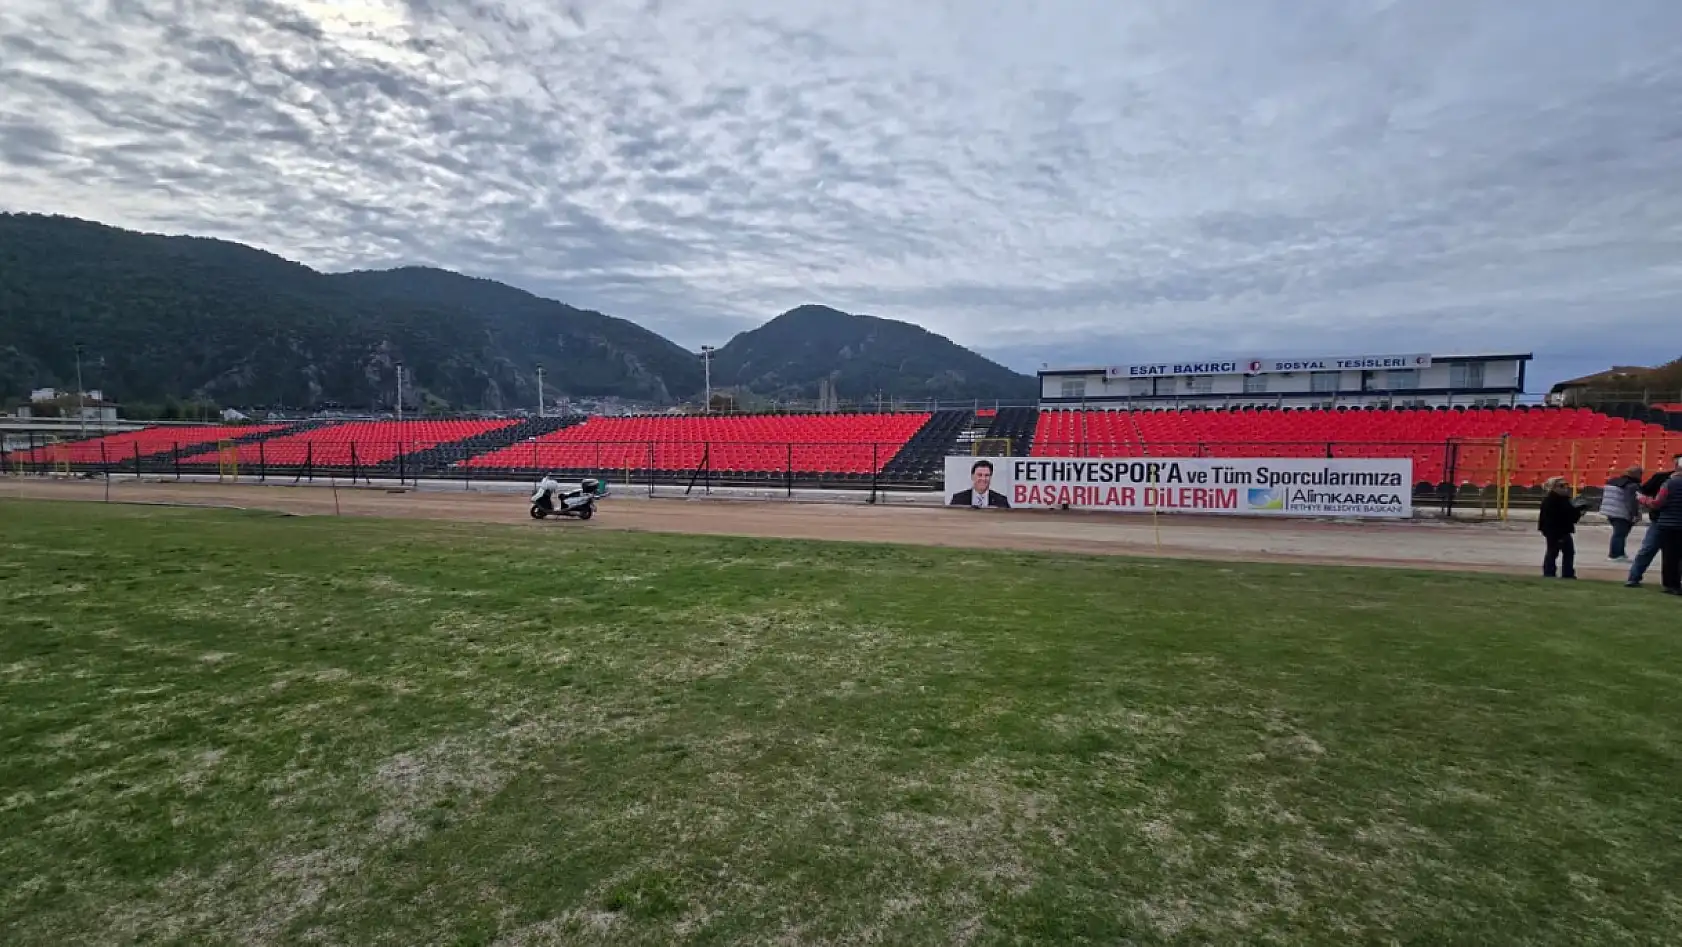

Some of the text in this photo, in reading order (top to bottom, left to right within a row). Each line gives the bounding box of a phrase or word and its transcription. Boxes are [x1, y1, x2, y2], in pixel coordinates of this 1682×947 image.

[1130, 362, 1236, 375] ESAT BAKIRCI
[1276, 361, 1326, 370] SOSYAL
[1187, 470, 1207, 483] ve
[1211, 467, 1252, 484] Tüm
[1256, 467, 1402, 487] Sporcularımıza
[1014, 484, 1135, 506] BAŞARILAR
